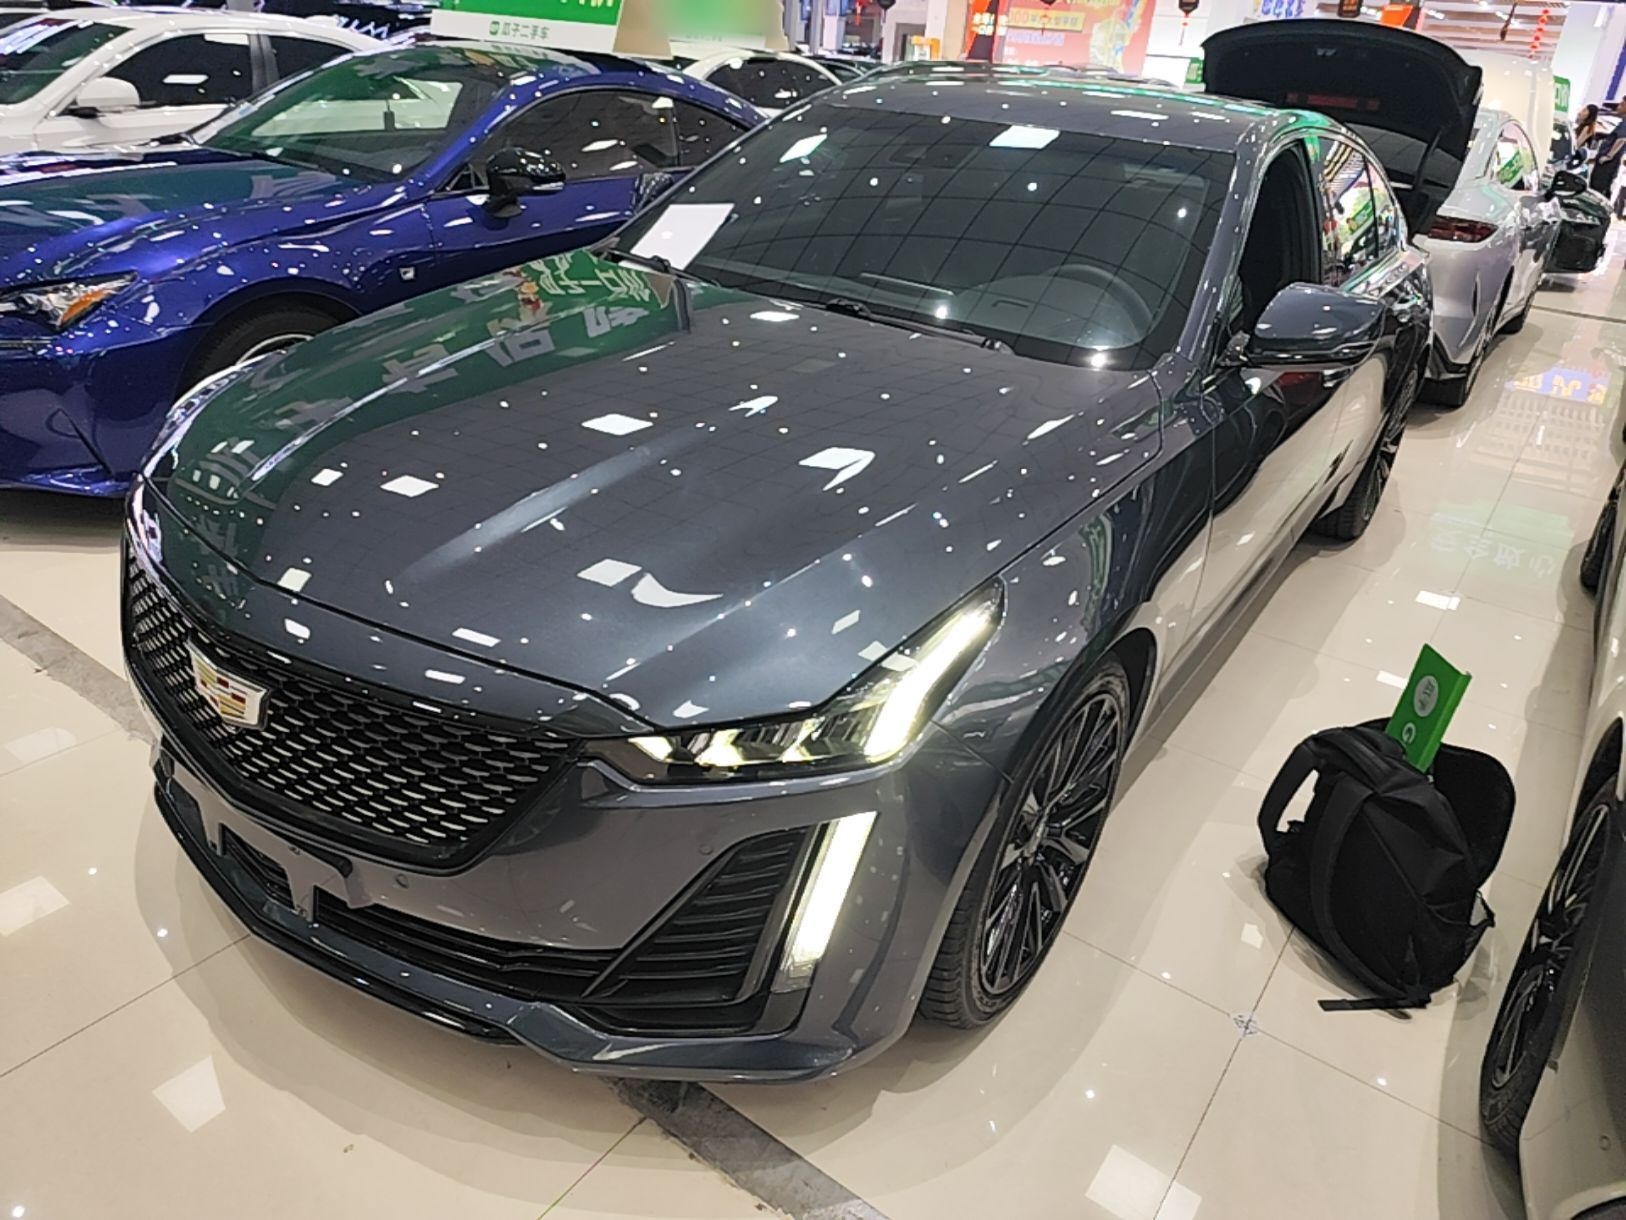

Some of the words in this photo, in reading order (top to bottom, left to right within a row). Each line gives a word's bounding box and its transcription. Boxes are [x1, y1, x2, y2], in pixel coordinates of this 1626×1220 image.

[501, 22, 550, 40] 瓜子二手车
